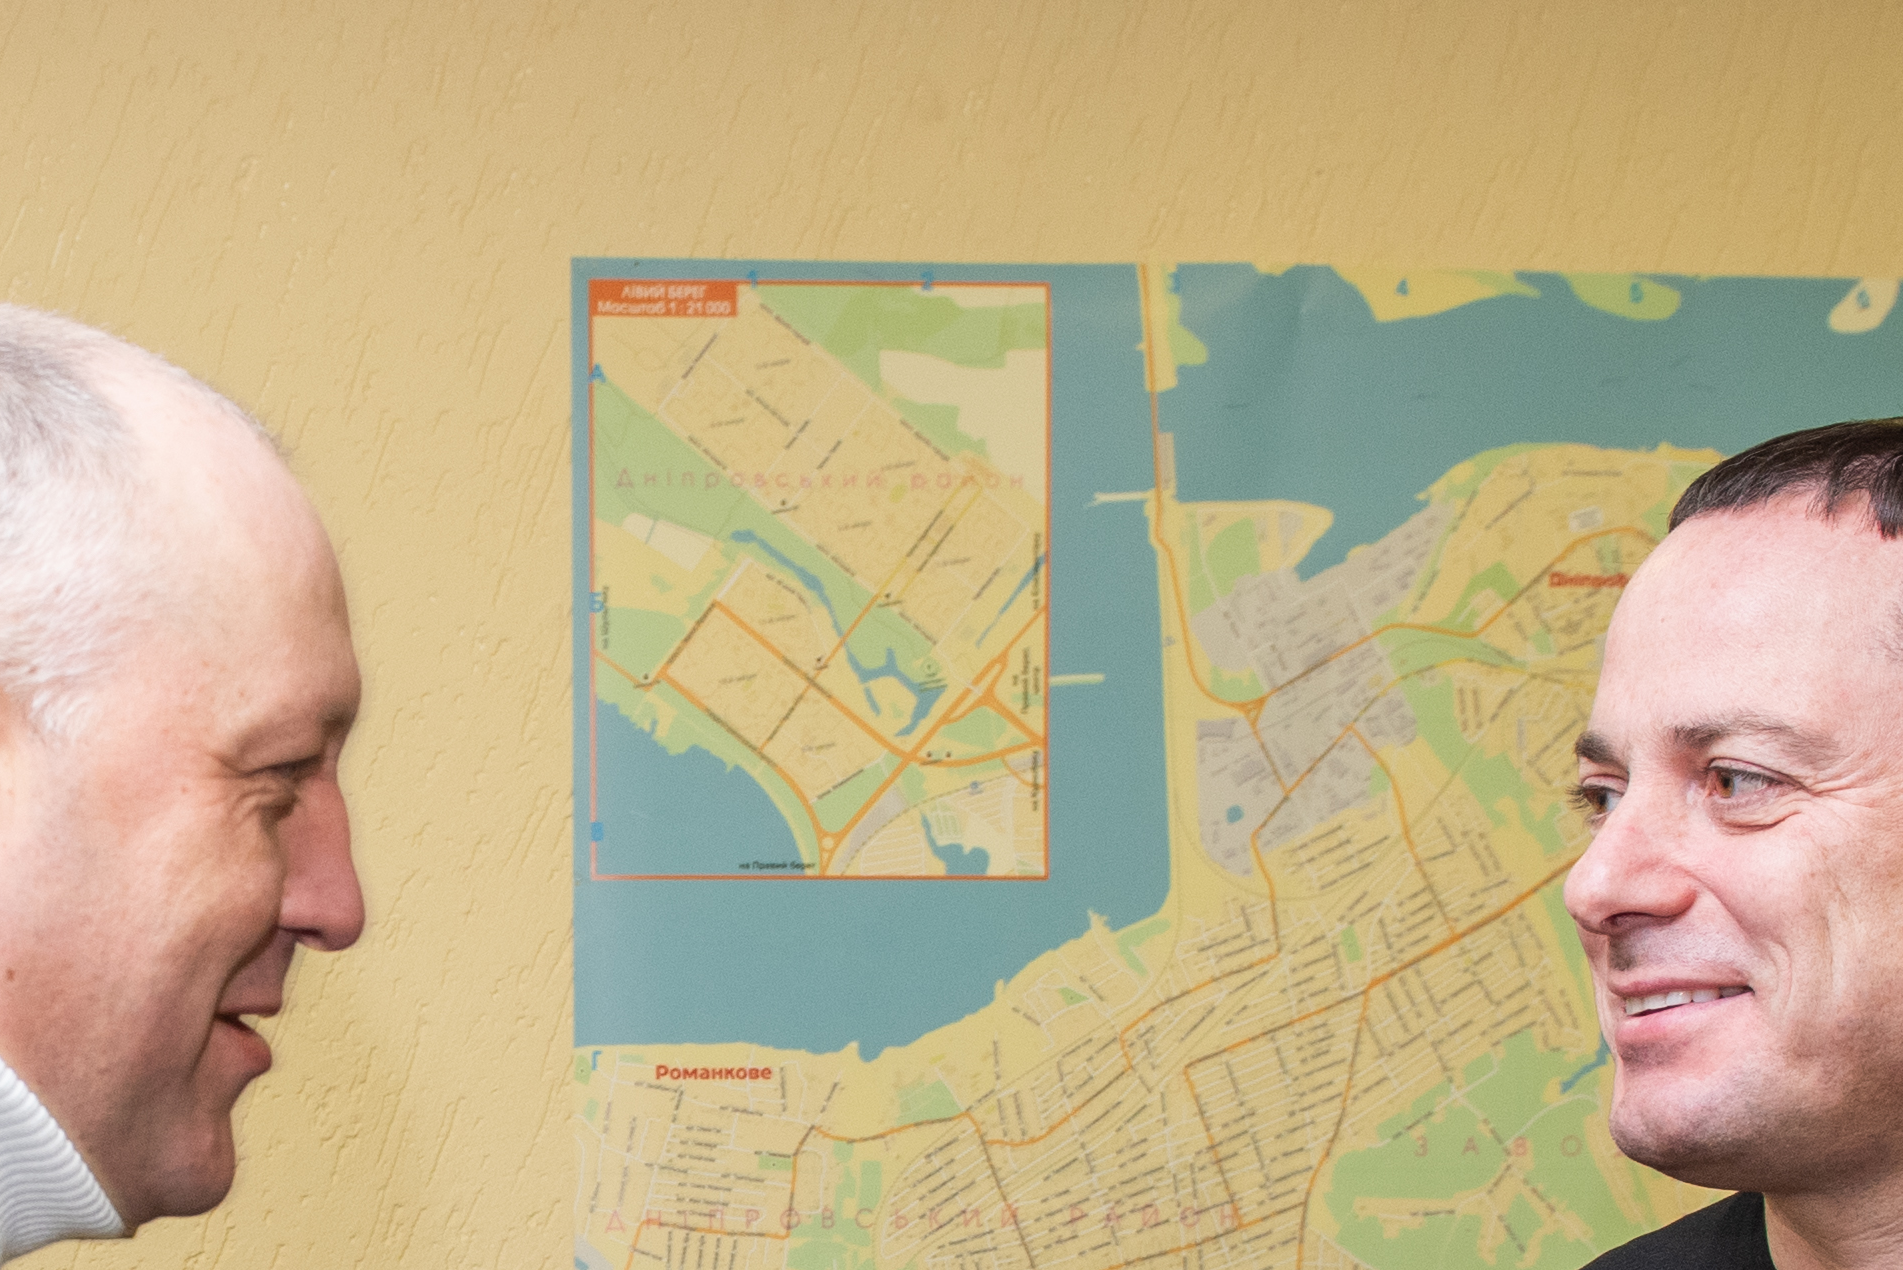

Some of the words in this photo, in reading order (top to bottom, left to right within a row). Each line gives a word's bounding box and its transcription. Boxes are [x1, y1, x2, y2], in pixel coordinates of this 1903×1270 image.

[621, 283, 665, 299] ЛІВИЙ
[668, 283, 707, 299] БЕРЕГ
[589, 364, 606, 383] А
[590, 592, 604, 613] Б
[752, 860, 787, 871] Правий
[655, 1065, 773, 1081] Романкове
